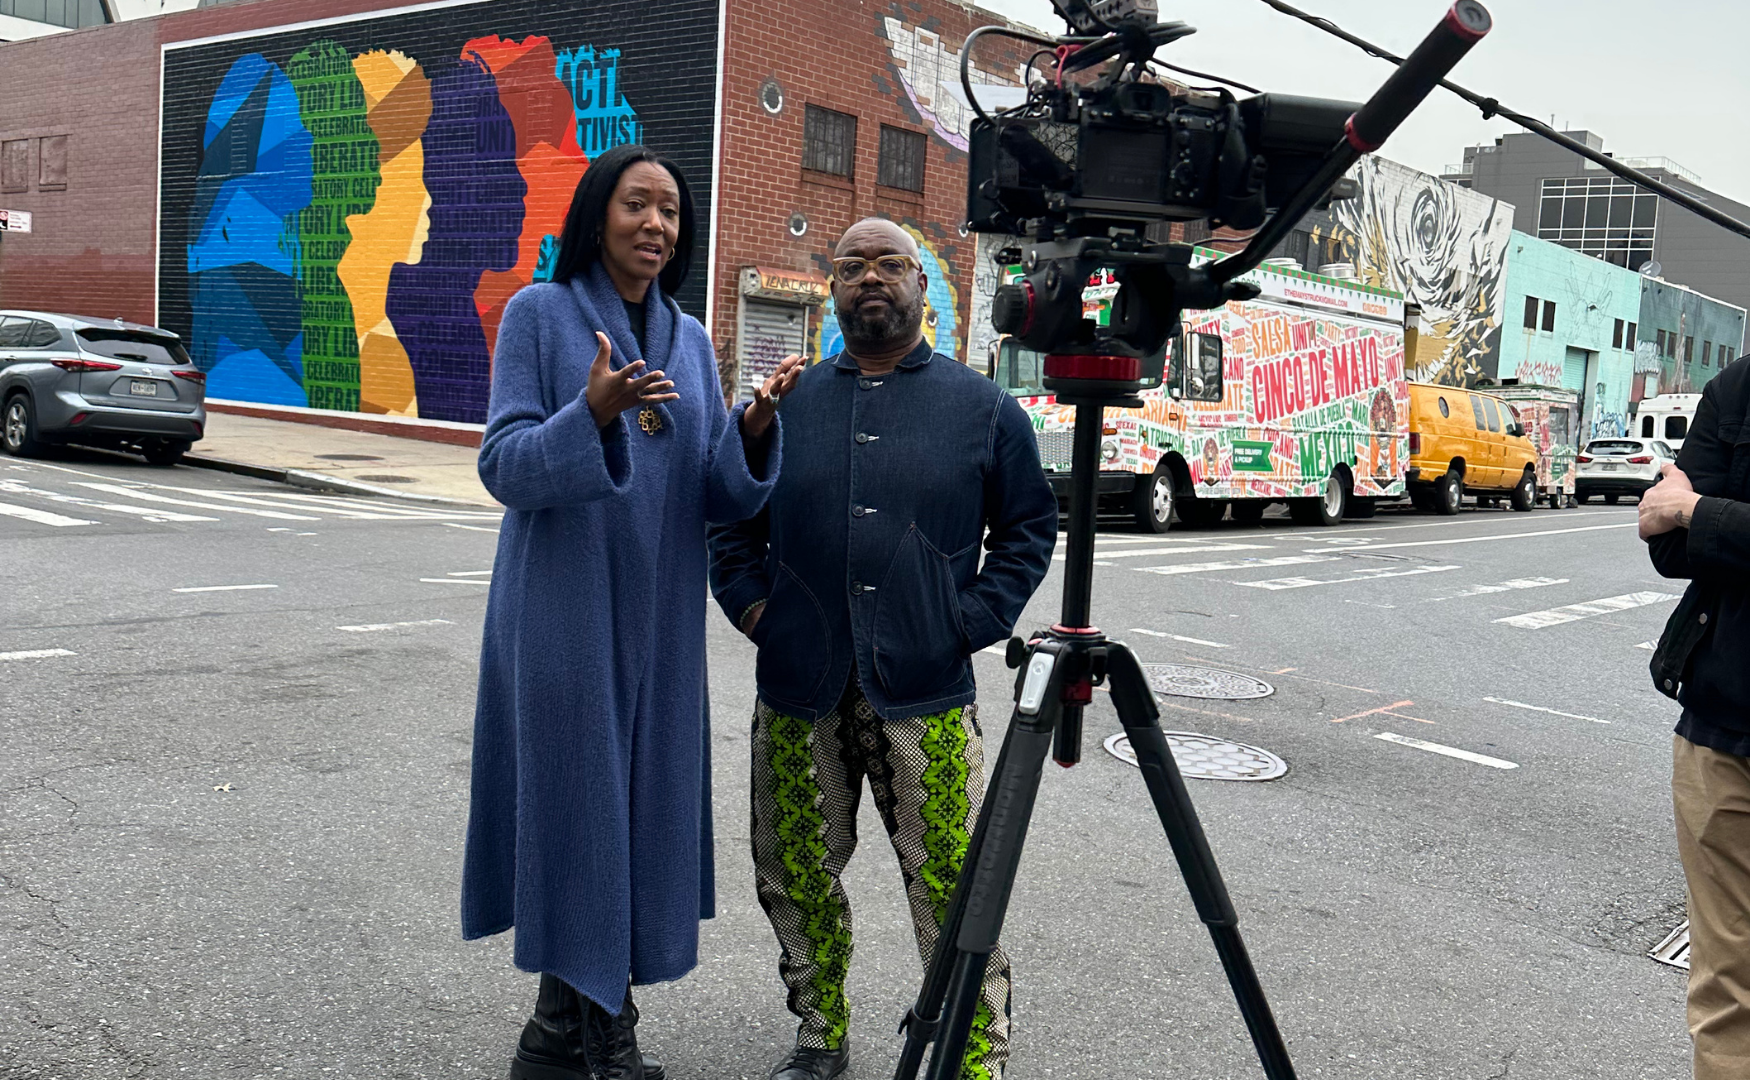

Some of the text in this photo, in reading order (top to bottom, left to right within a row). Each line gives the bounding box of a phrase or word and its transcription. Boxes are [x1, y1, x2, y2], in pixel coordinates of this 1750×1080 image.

[1252, 315, 1292, 360] SALSA
[1252, 355, 1306, 425] CINCO
[1308, 349, 1331, 408] DE
[1332, 336, 1380, 400] MAYO
